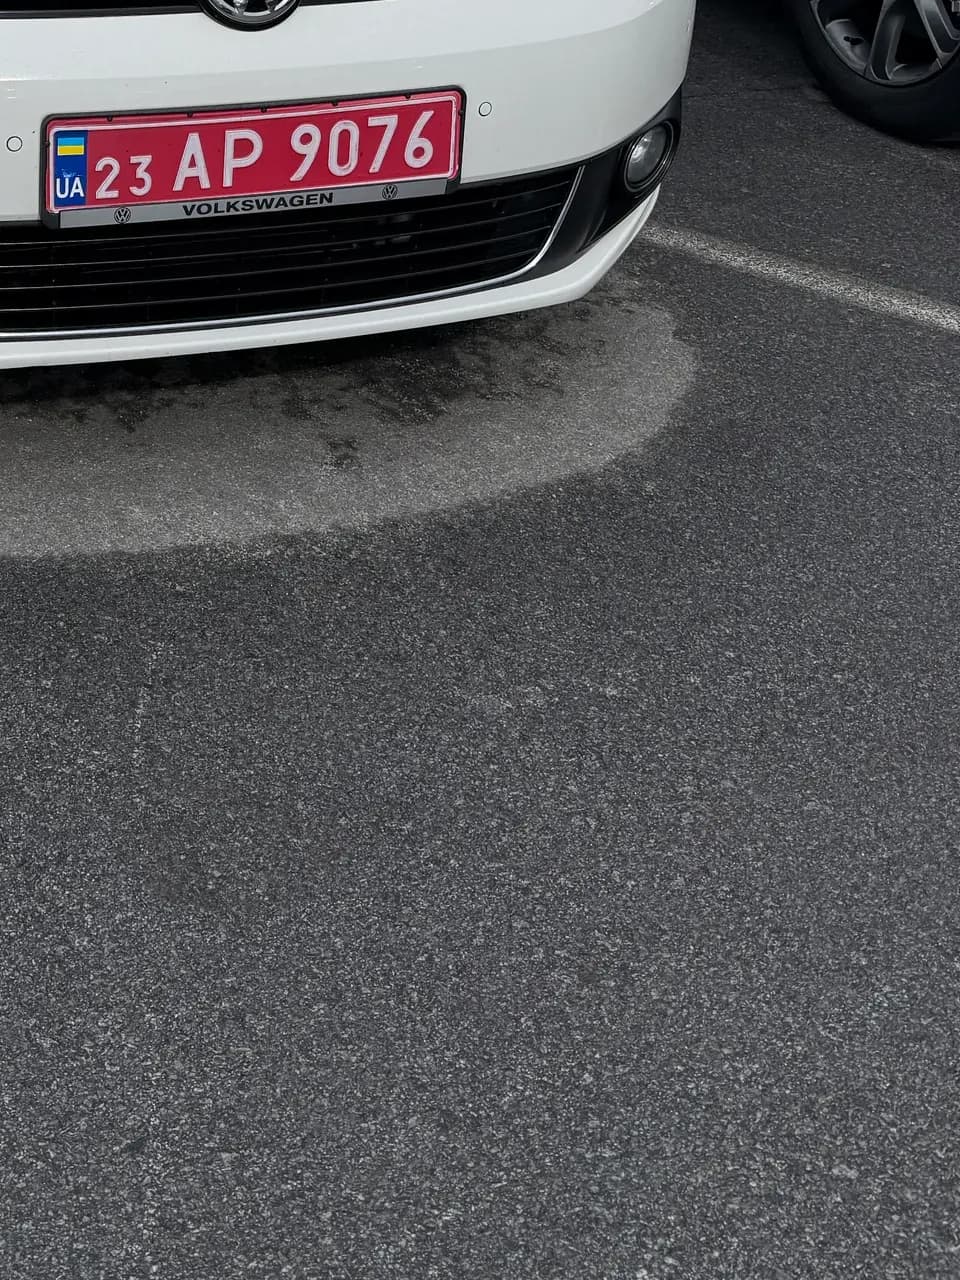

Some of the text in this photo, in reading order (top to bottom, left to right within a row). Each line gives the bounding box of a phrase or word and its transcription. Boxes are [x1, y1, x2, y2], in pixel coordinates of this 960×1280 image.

[56, 110, 435, 200] UA 23 AP 9076
[182, 191, 334, 217] VOLKSWAGEN
